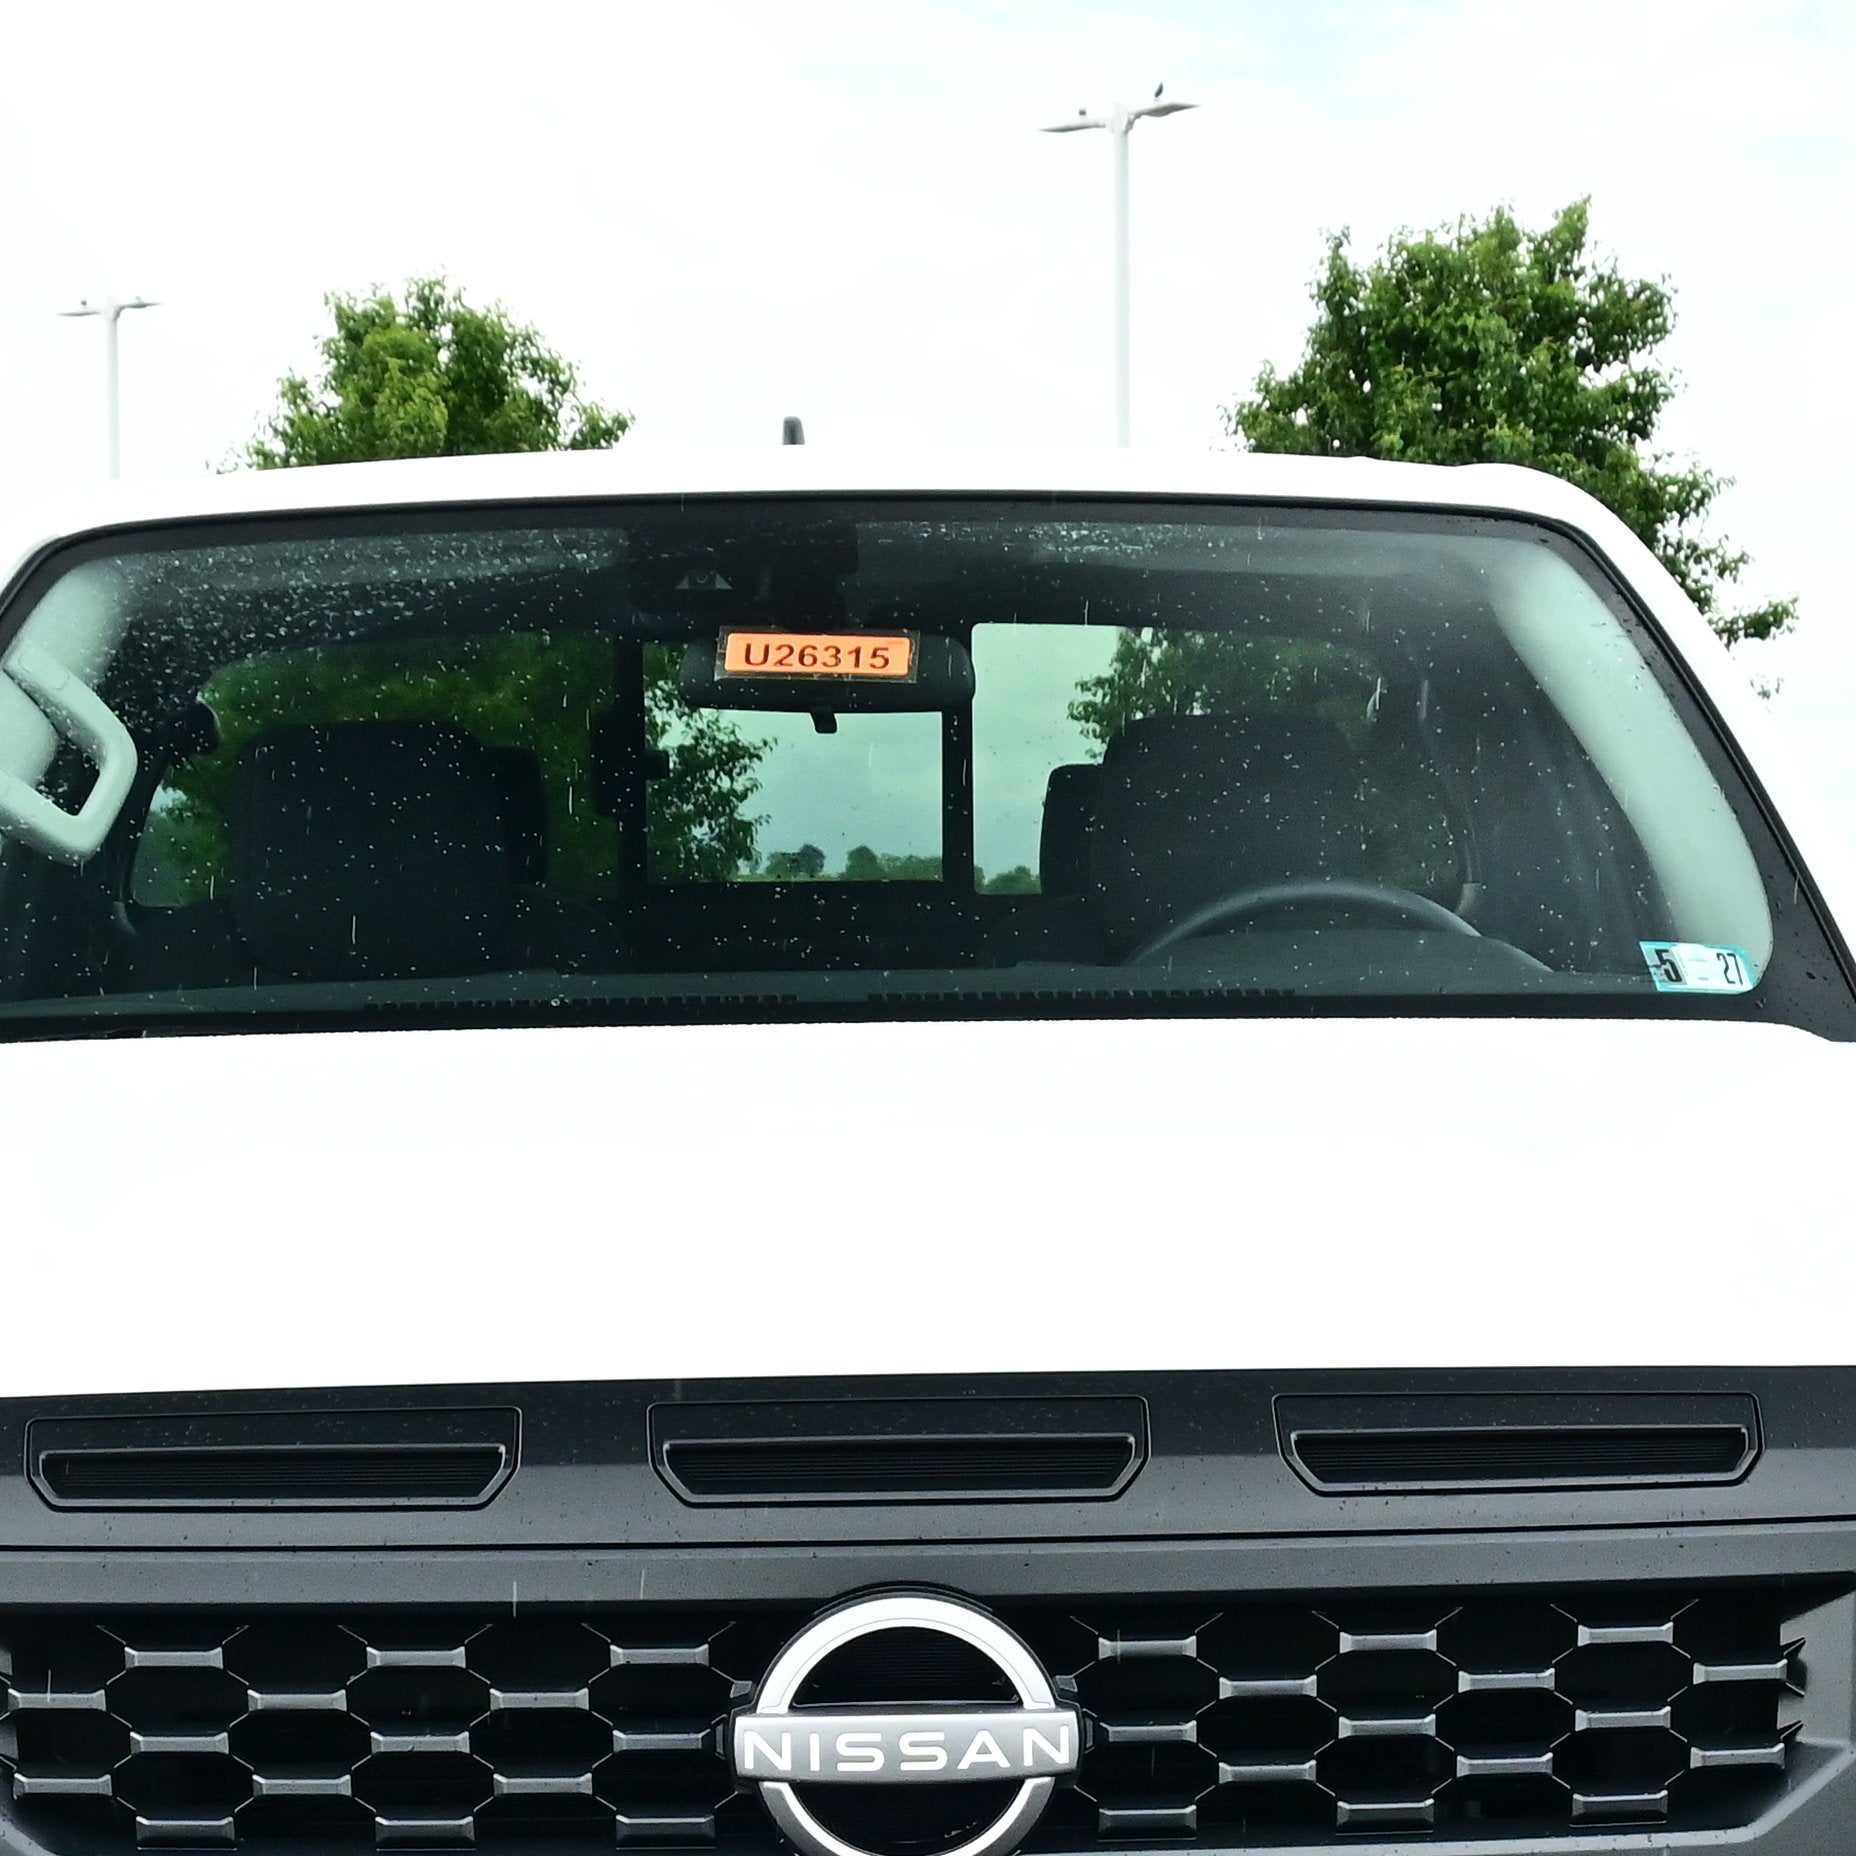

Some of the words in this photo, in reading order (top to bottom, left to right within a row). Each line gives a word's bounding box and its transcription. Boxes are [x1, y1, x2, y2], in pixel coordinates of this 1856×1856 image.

[744, 642, 890, 669] U26315
[1654, 948, 1683, 983] 5
[1716, 952, 1744, 986] 27
[743, 1725, 1070, 1772] NISSAN
